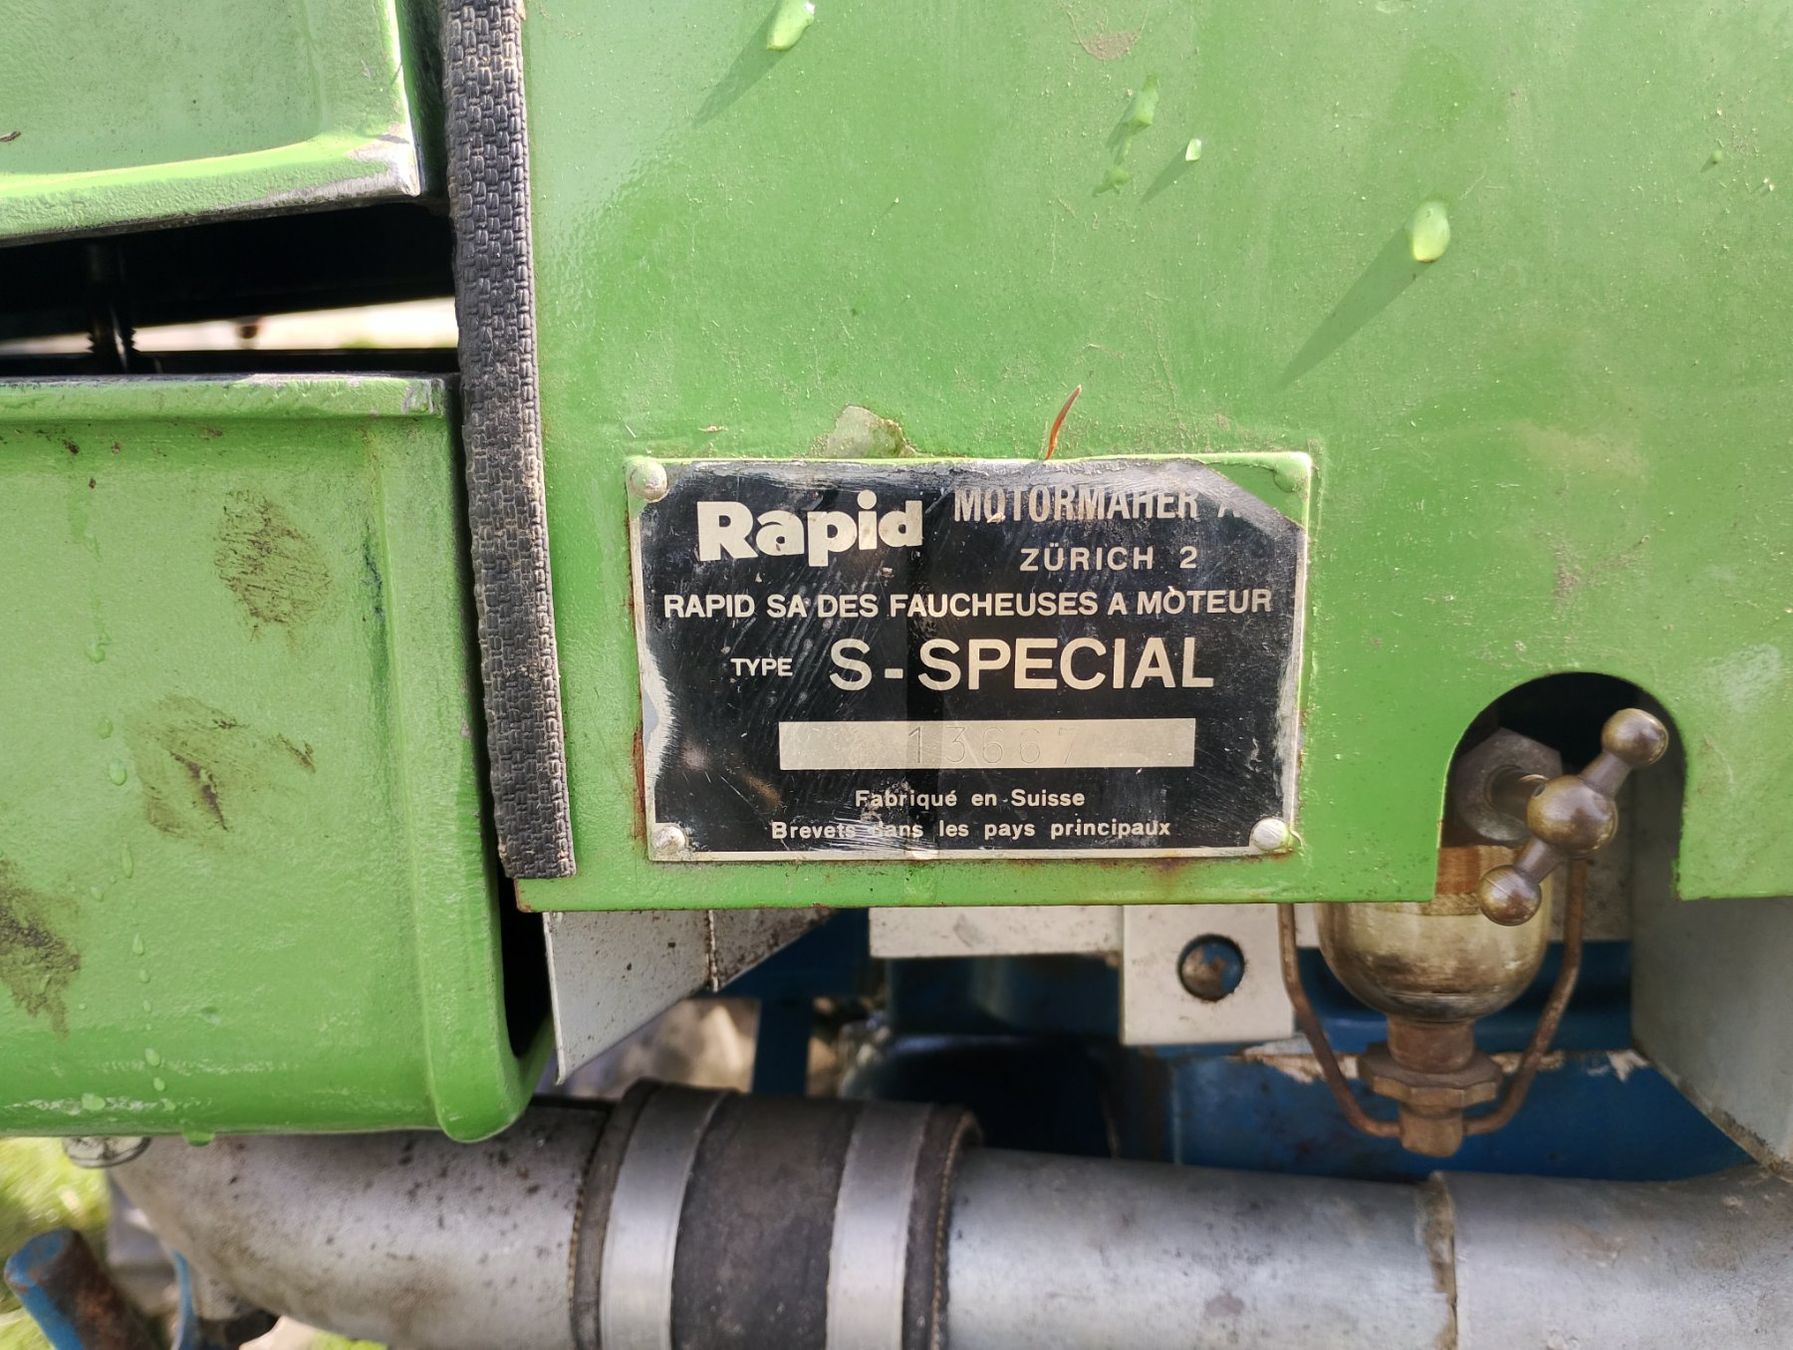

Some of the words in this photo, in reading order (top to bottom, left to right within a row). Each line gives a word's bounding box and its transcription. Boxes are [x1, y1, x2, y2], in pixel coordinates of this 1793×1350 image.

[696, 489, 924, 567] Rapid
[1019, 543, 1154, 572] ZÜRICH
[1179, 546, 1198, 569] 2
[664, 594, 755, 618] RAPID
[766, 594, 808, 618] SA
[817, 594, 879, 618] DES
[890, 592, 1098, 618] FAUCHEUSES
[1107, 593, 1128, 615] A
[730, 657, 793, 677] TYPE
[855, 789, 957, 810] Fabriqué
[971, 793, 997, 806] en
[1011, 788, 1085, 806] Suisse
[771, 821, 856, 840] Brevets
[939, 819, 969, 838] les
[984, 822, 1036, 840] pays
[1050, 818, 1172, 840] principaux
